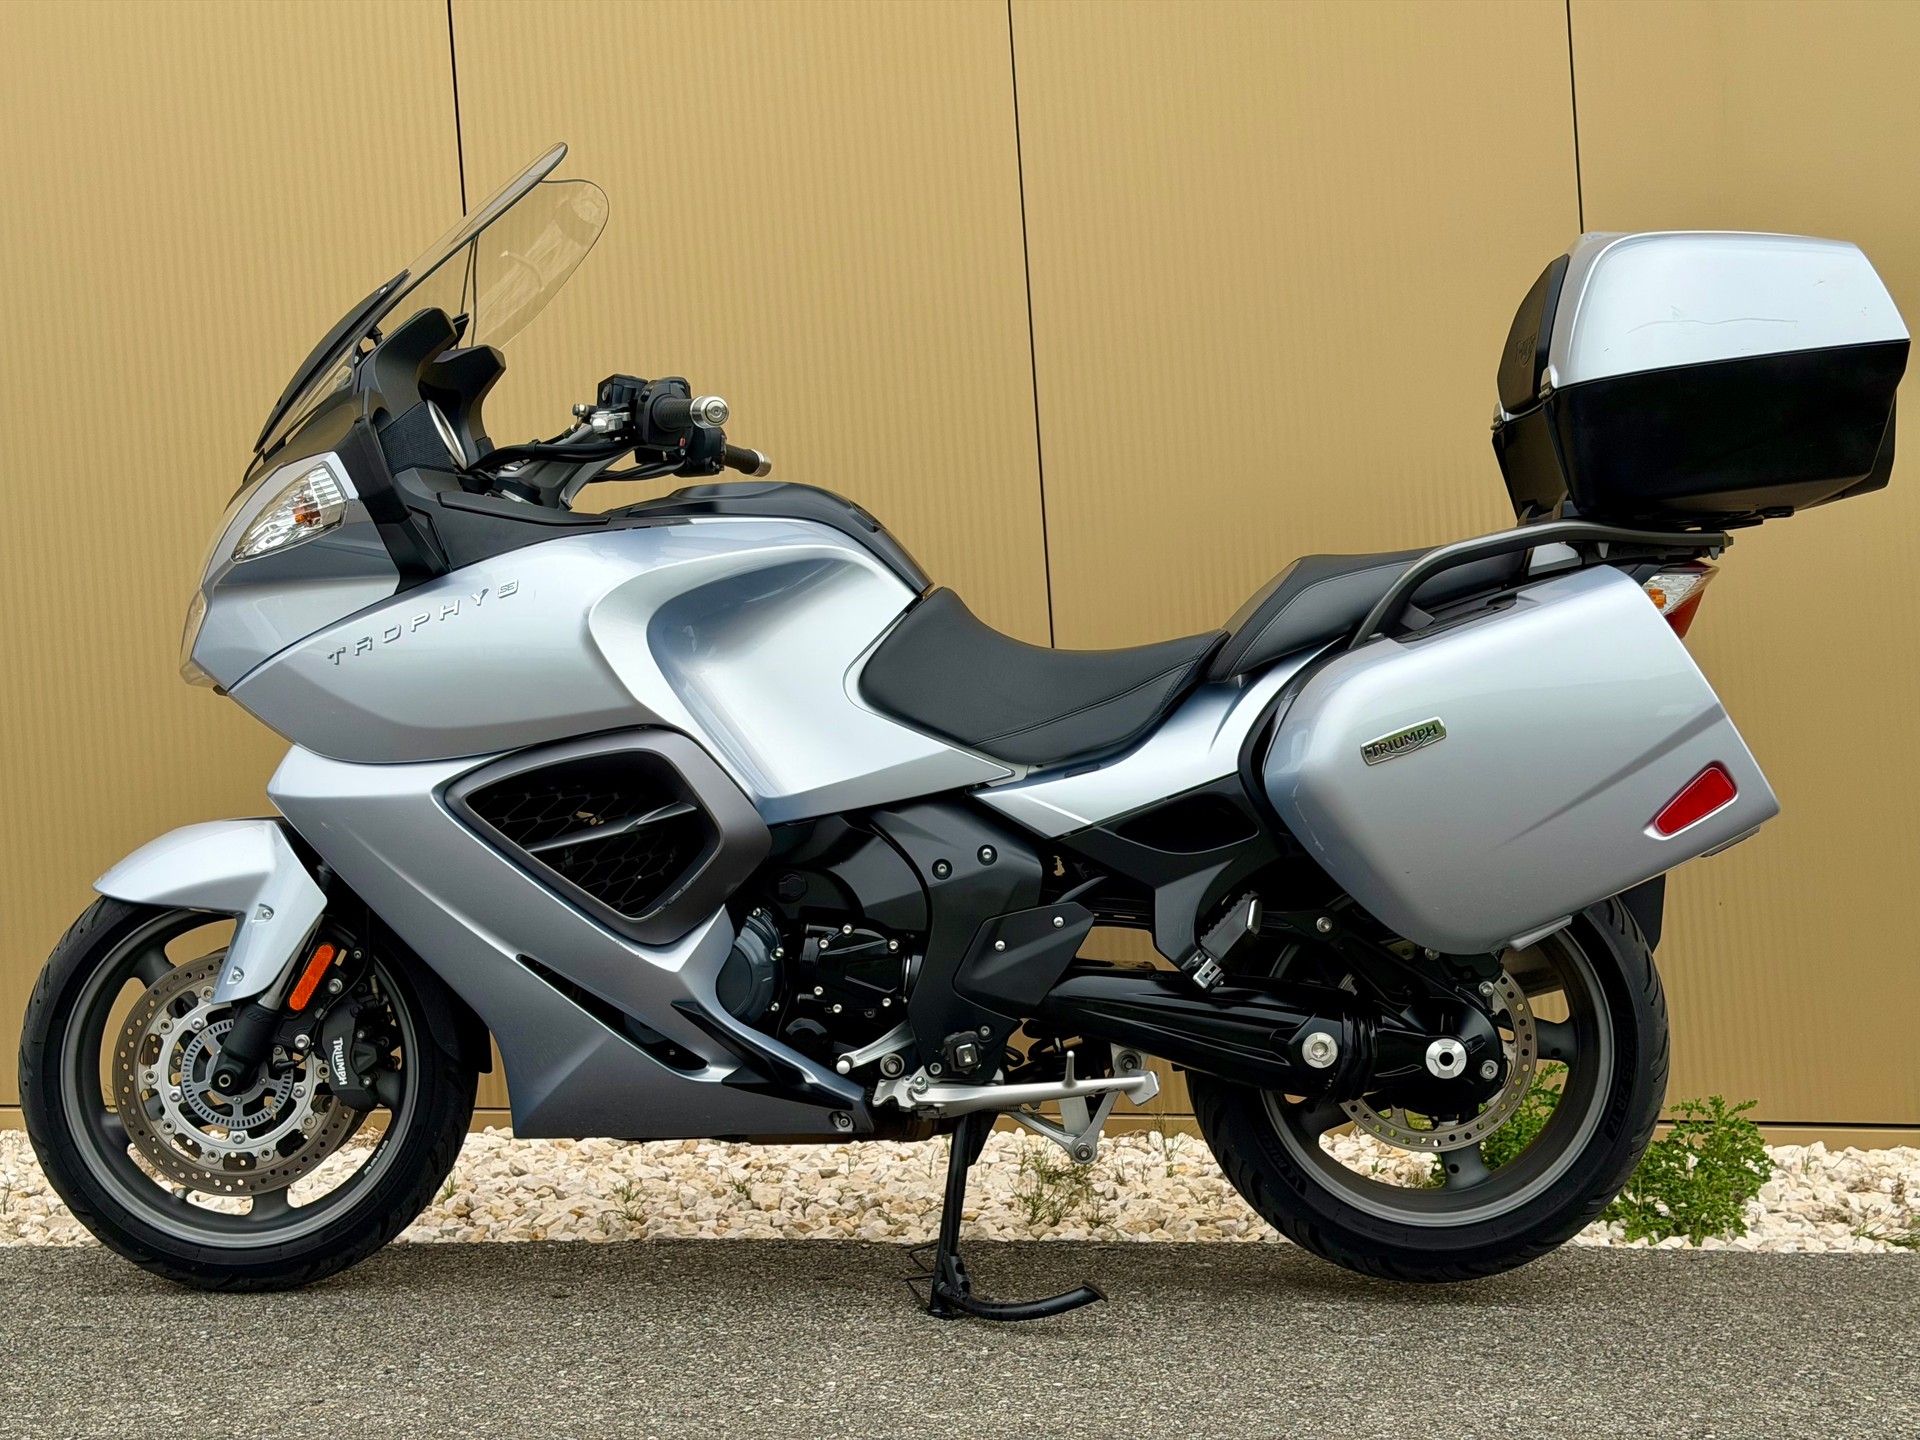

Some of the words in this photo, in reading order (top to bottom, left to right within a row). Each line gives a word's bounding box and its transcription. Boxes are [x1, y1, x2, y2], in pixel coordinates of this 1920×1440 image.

[328, 588, 489, 665] TROPHY
[499, 580, 517, 595] SE
[1364, 724, 1438, 757] TRIUMPH
[332, 1036, 348, 1086] TRIUMPH
